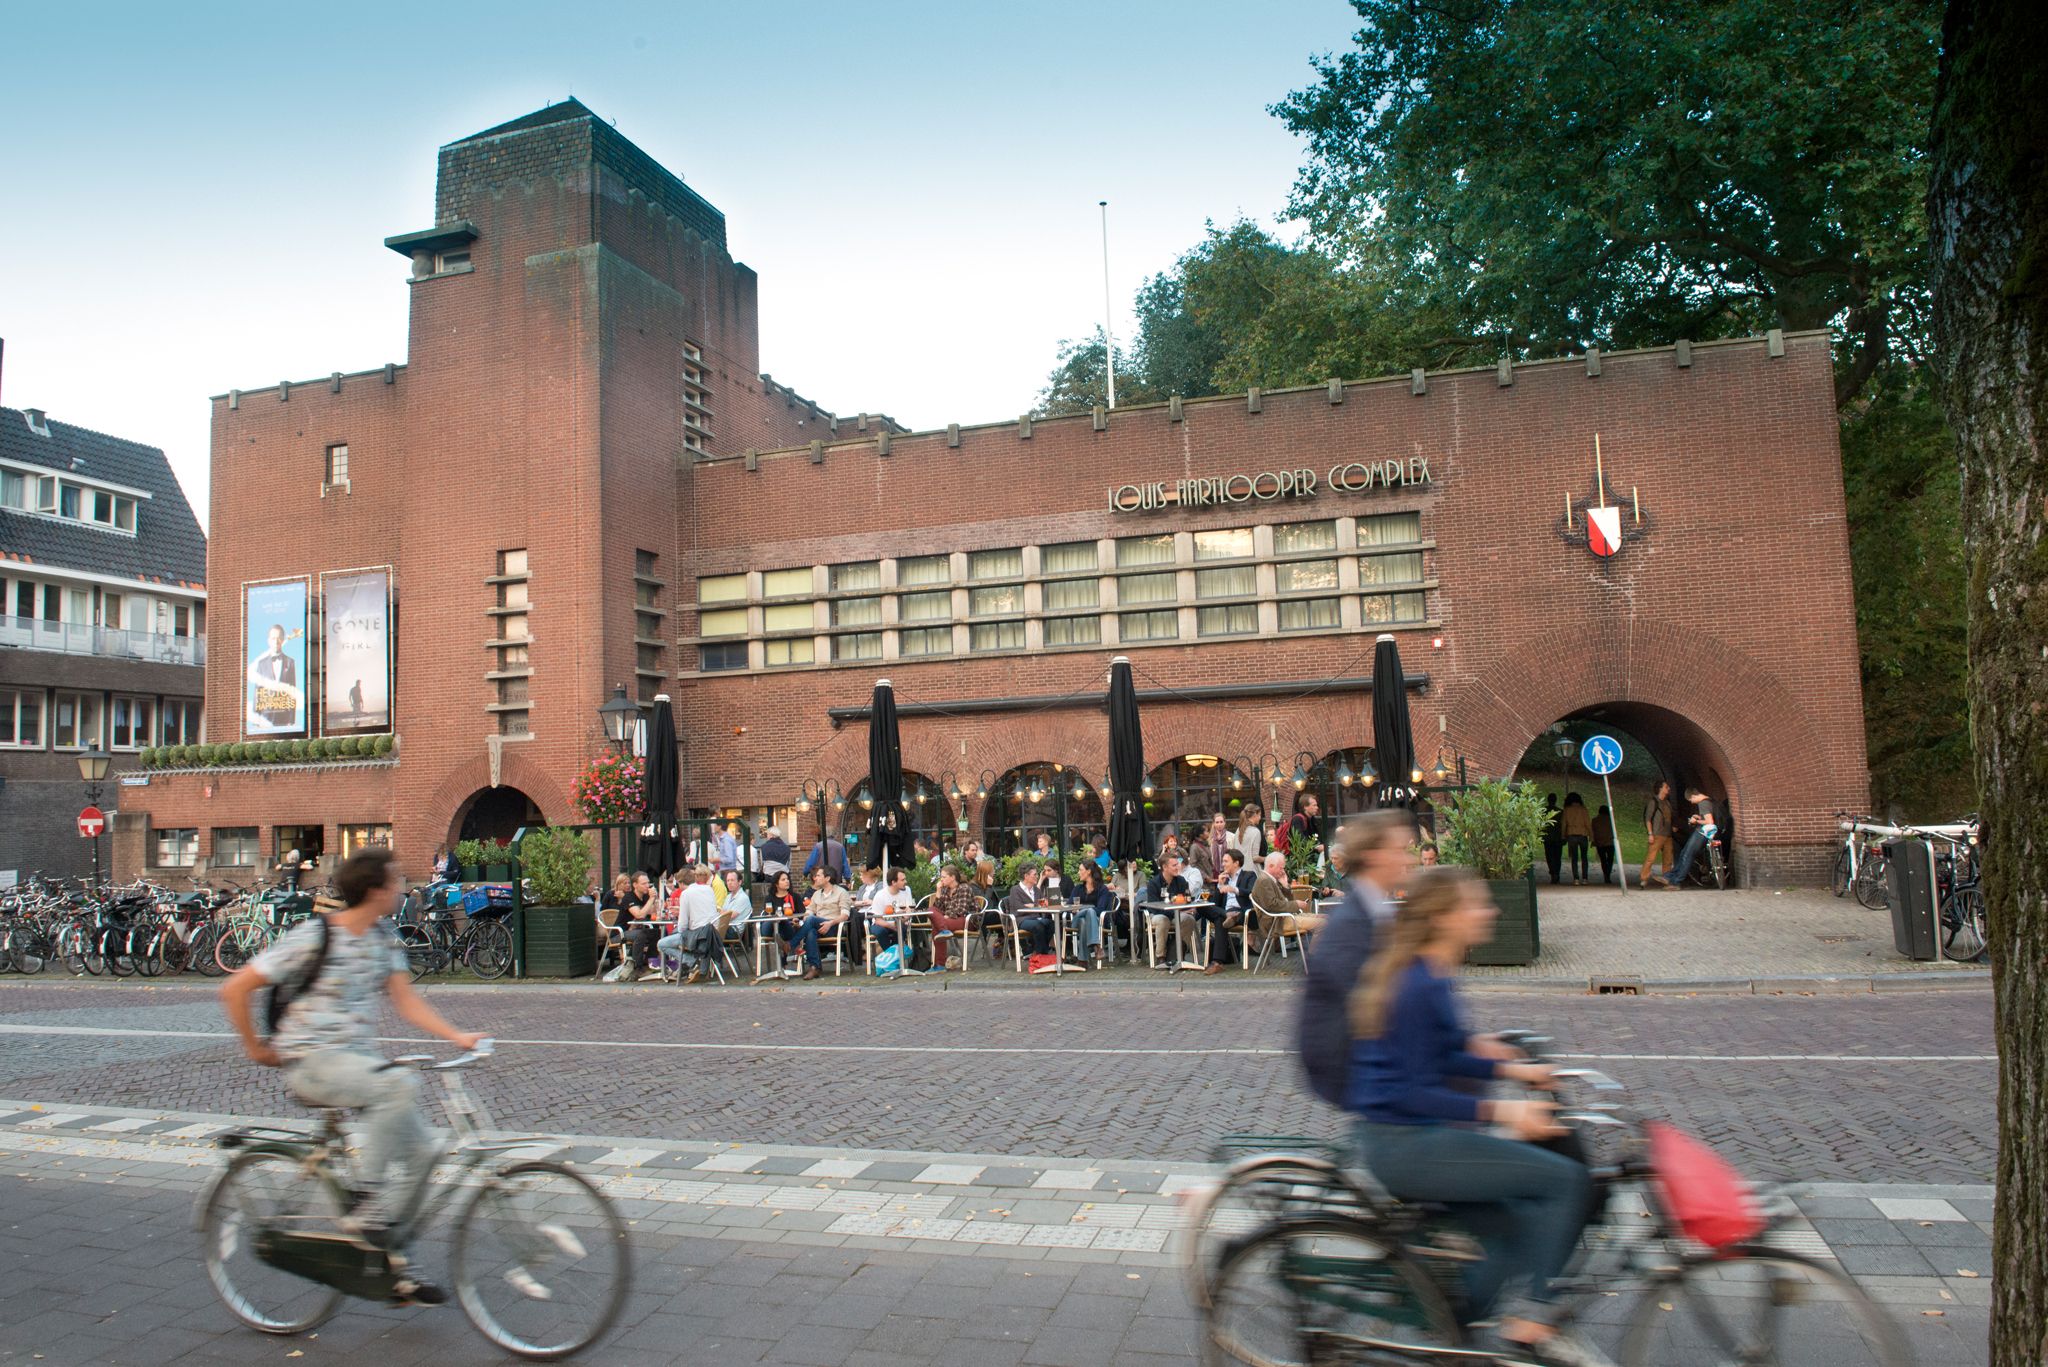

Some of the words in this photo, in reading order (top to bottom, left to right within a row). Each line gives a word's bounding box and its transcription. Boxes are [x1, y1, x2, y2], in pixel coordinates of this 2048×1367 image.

[1108, 482, 1167, 513] LOUIS
[1176, 469, 1317, 507] HARTLOOPER
[1328, 457, 1432, 492] COMPLEX
[332, 617, 380, 634] GONE
